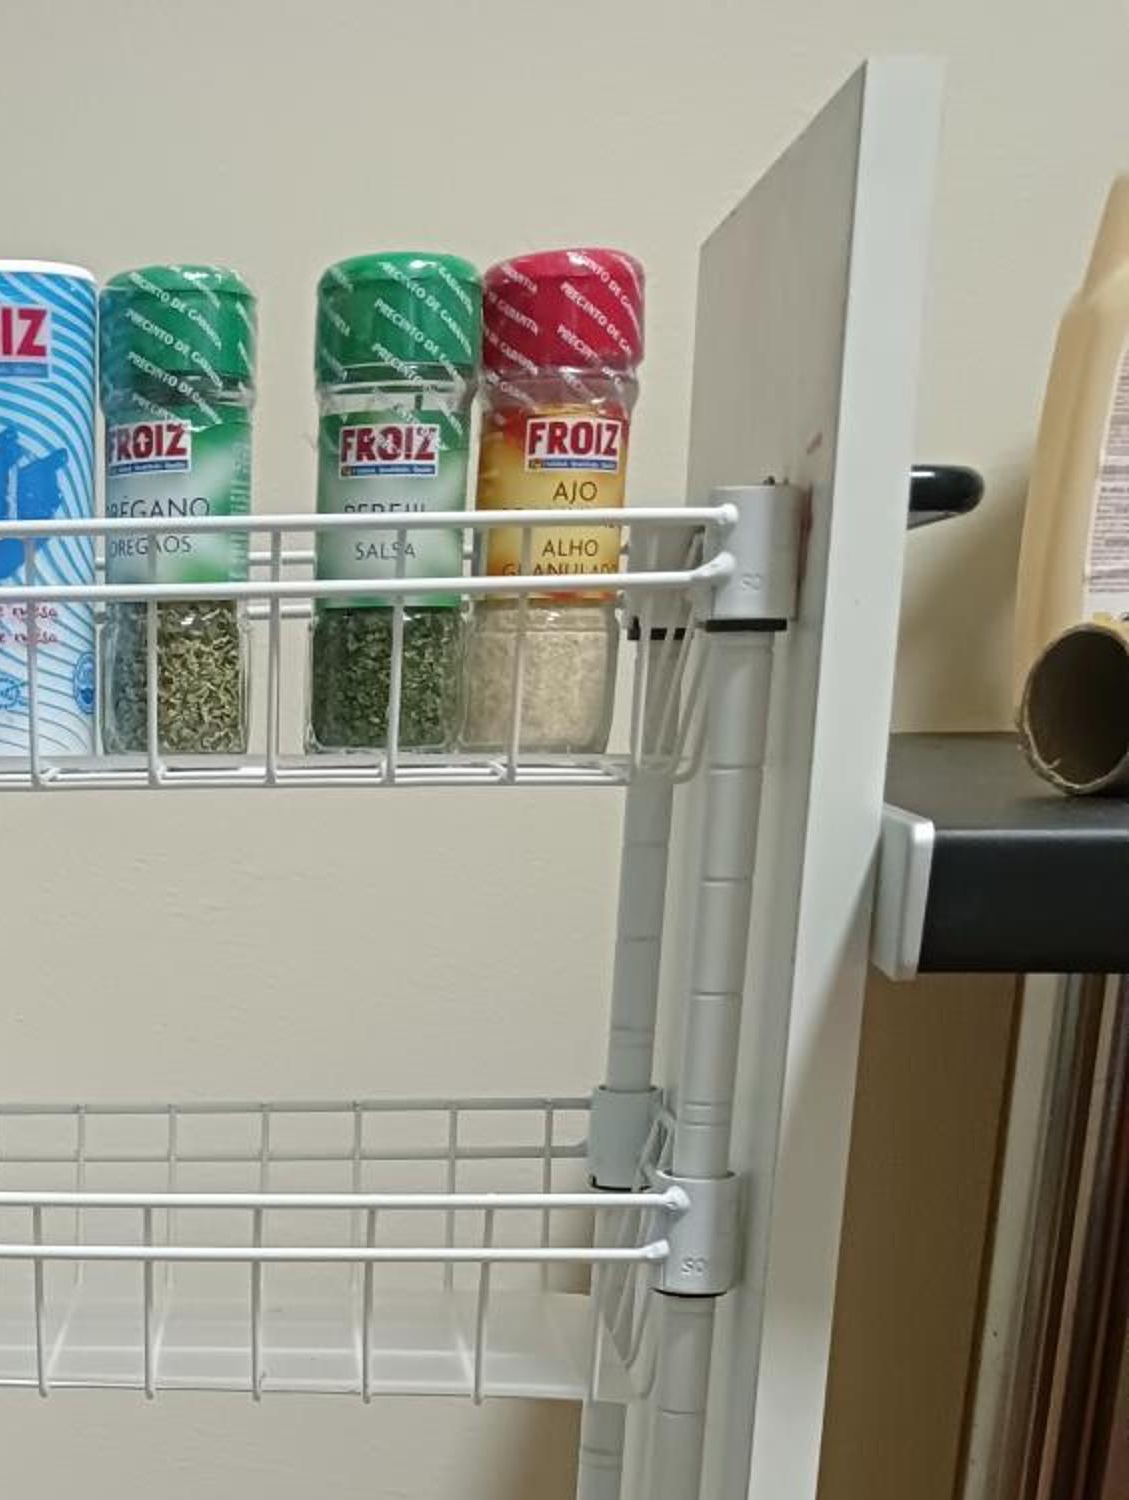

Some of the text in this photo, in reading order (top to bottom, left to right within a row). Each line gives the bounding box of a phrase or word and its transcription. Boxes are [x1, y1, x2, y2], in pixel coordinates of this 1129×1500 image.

[341, 426, 437, 463] FROIZ
[528, 421, 620, 456] FROIZ
[553, 481, 599, 505] AJO
[542, 539, 599, 558] ALHO
[12, 606, 59, 621] msa
[14, 630, 59, 646] msa
